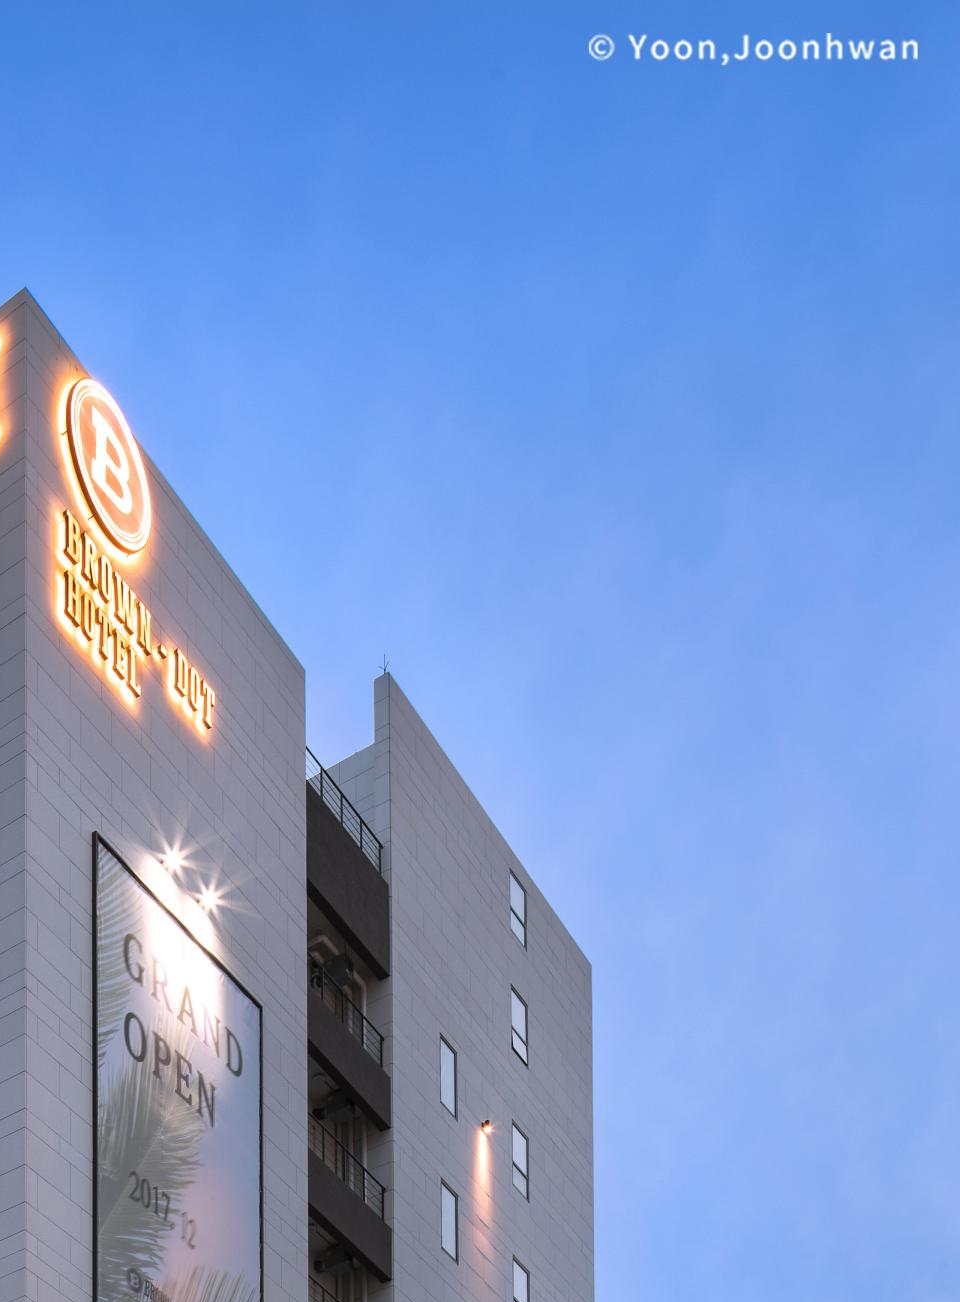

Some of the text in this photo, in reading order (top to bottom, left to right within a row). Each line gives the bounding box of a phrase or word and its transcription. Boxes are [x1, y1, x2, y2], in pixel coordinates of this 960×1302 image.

[63, 509, 152, 657] BROWN
[174, 648, 216, 729] DOT
[64, 570, 141, 698] HOTEL
[123, 933, 244, 1078] GRAND
[123, 1012, 217, 1128] OPEN
